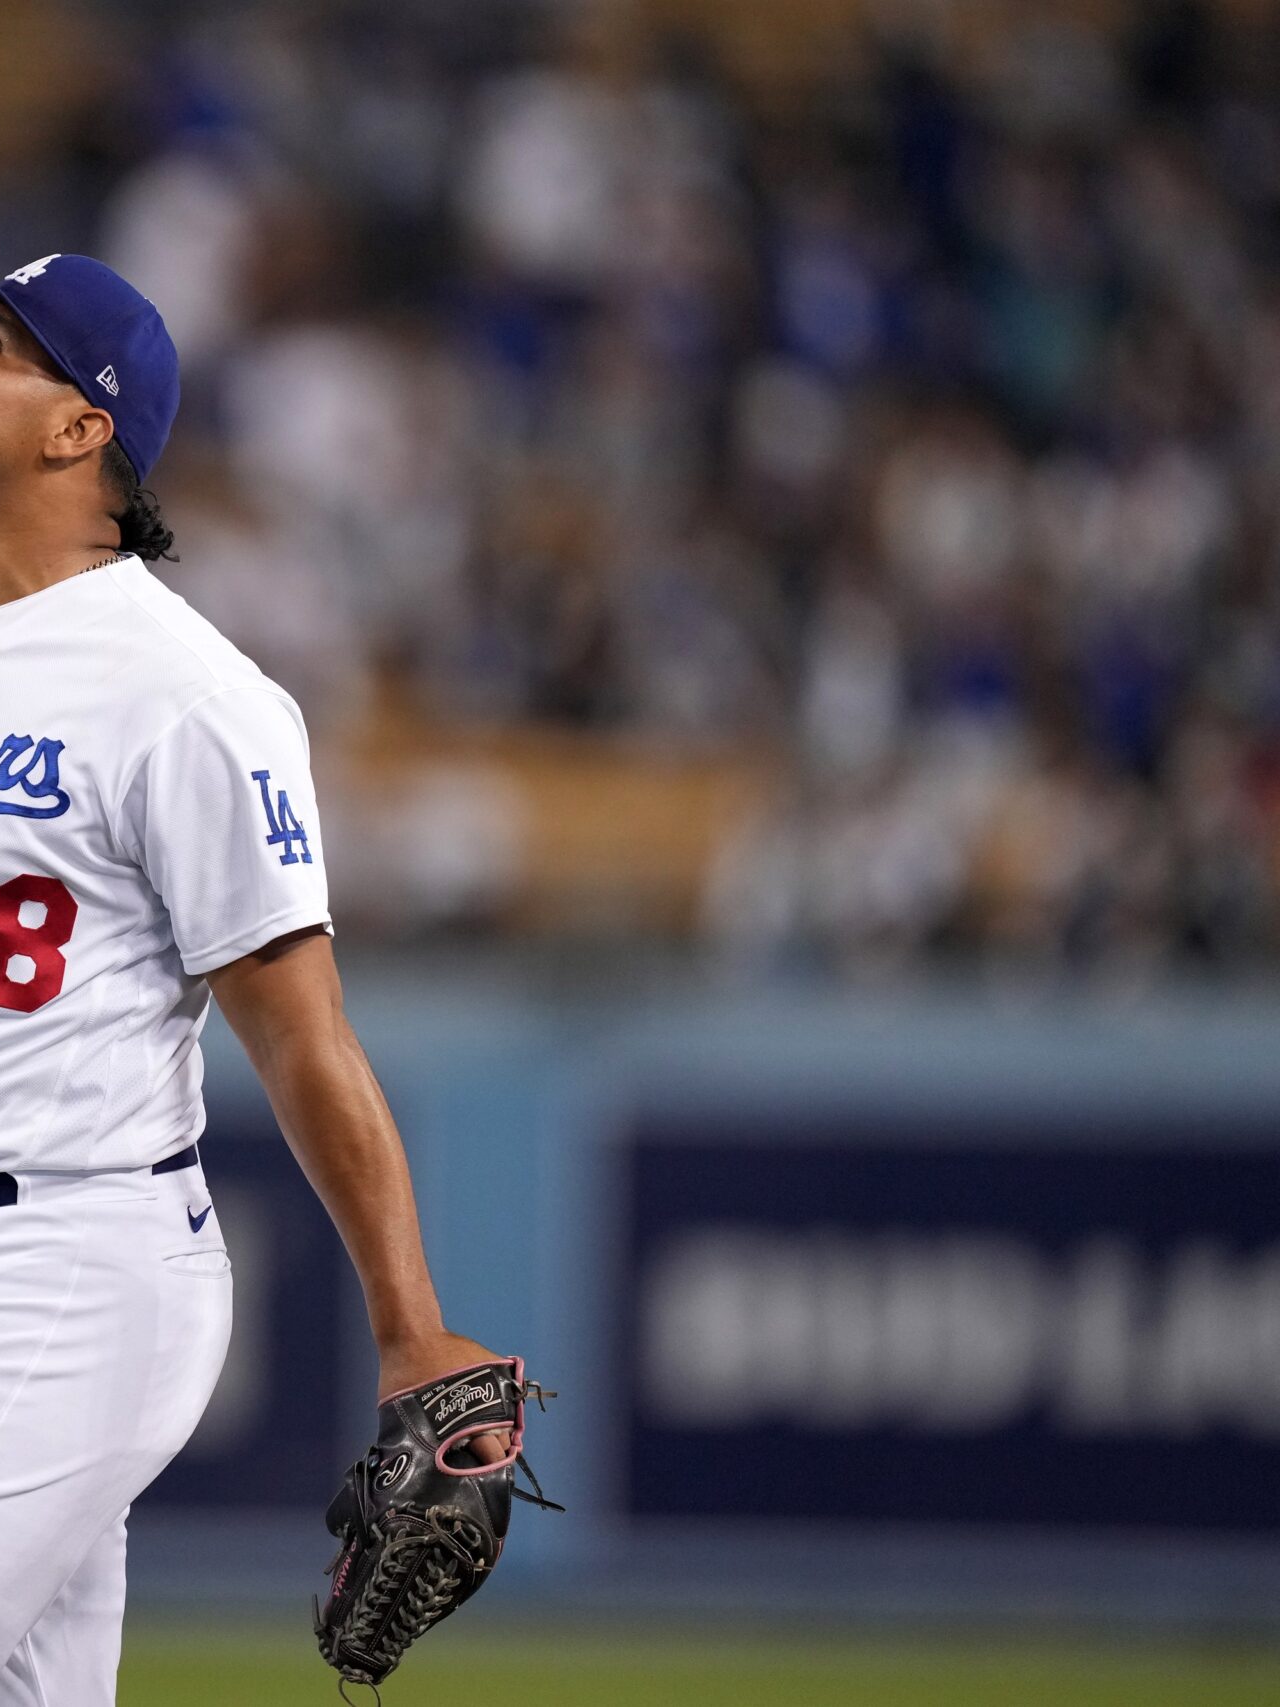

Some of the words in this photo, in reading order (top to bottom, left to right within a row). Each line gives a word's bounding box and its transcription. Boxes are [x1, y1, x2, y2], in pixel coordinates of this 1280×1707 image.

[251, 770, 313, 866] LA
[434, 1382, 494, 1422] Rawlings
[333, 1555, 352, 1597] MAMA
